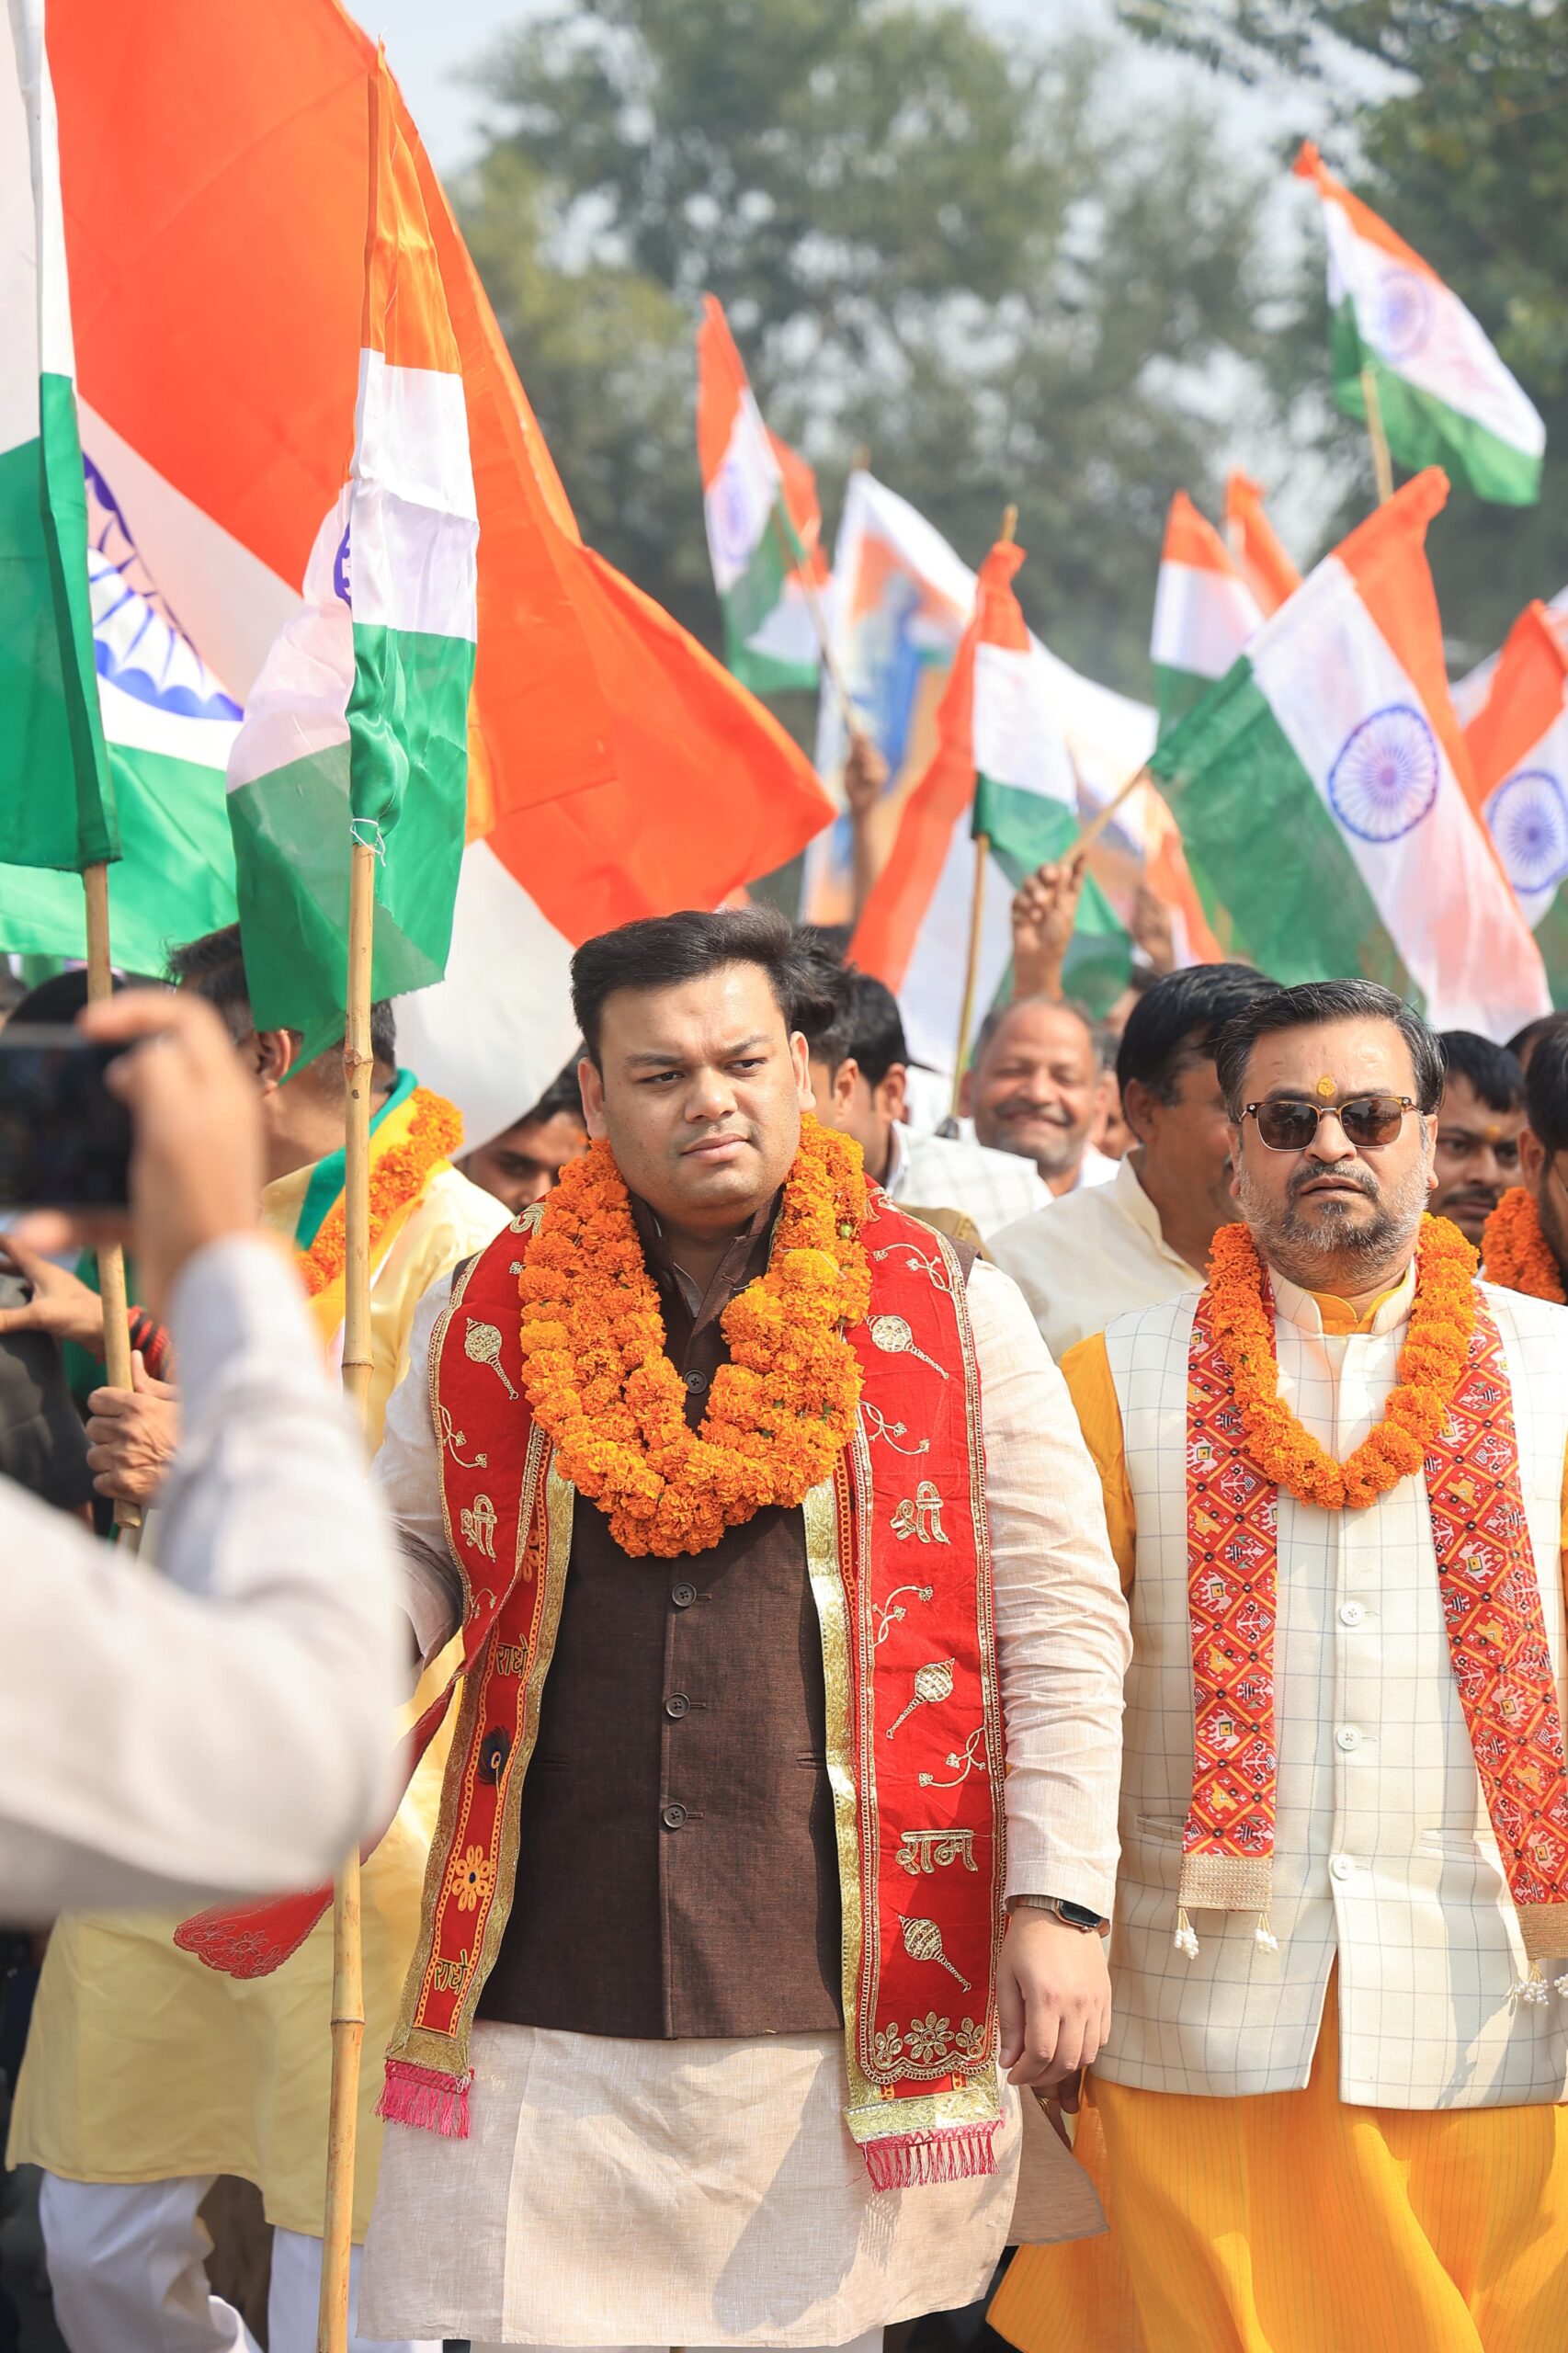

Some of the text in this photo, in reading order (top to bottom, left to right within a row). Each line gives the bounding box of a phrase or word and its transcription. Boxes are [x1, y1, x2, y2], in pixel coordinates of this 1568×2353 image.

[460, 1494, 497, 1563] श्री
[890, 1481, 950, 1544] श्री
[495, 1632, 528, 1678] राधे
[895, 1828, 978, 1875] राम
[434, 1949, 470, 1995] राधे
